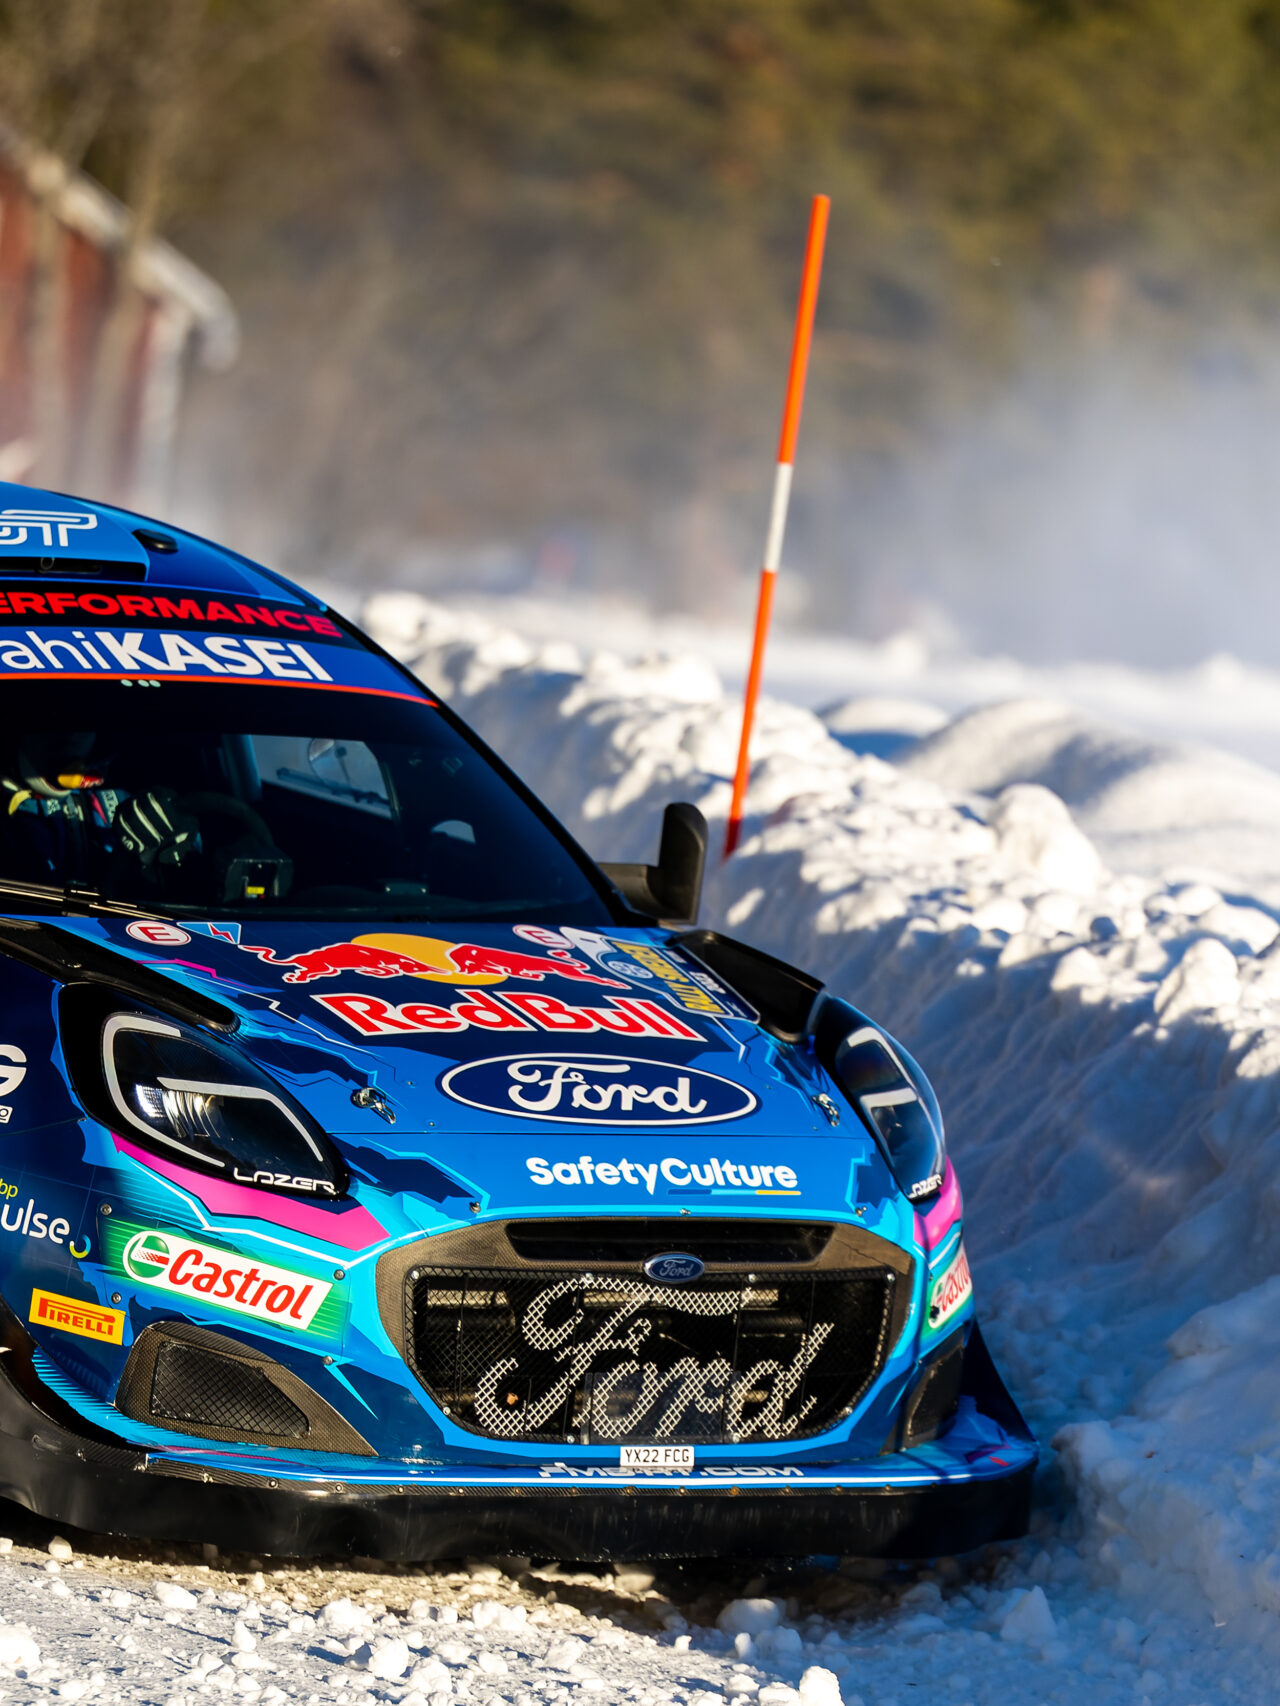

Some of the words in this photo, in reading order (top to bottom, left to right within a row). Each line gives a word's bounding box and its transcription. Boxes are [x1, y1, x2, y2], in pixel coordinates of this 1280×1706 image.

[507, 1060, 708, 1116] Ford
[233, 1168, 337, 1195] LAZER
[526, 1156, 799, 1195] SafetyCulture
[168, 1248, 314, 1320] Castrol
[659, 1259, 694, 1277] Ford
[38, 1296, 116, 1336] PIRELLI
[475, 1275, 834, 1440] Ford
[624, 1449, 659, 1463] YX22
[663, 1449, 690, 1463] FCG
